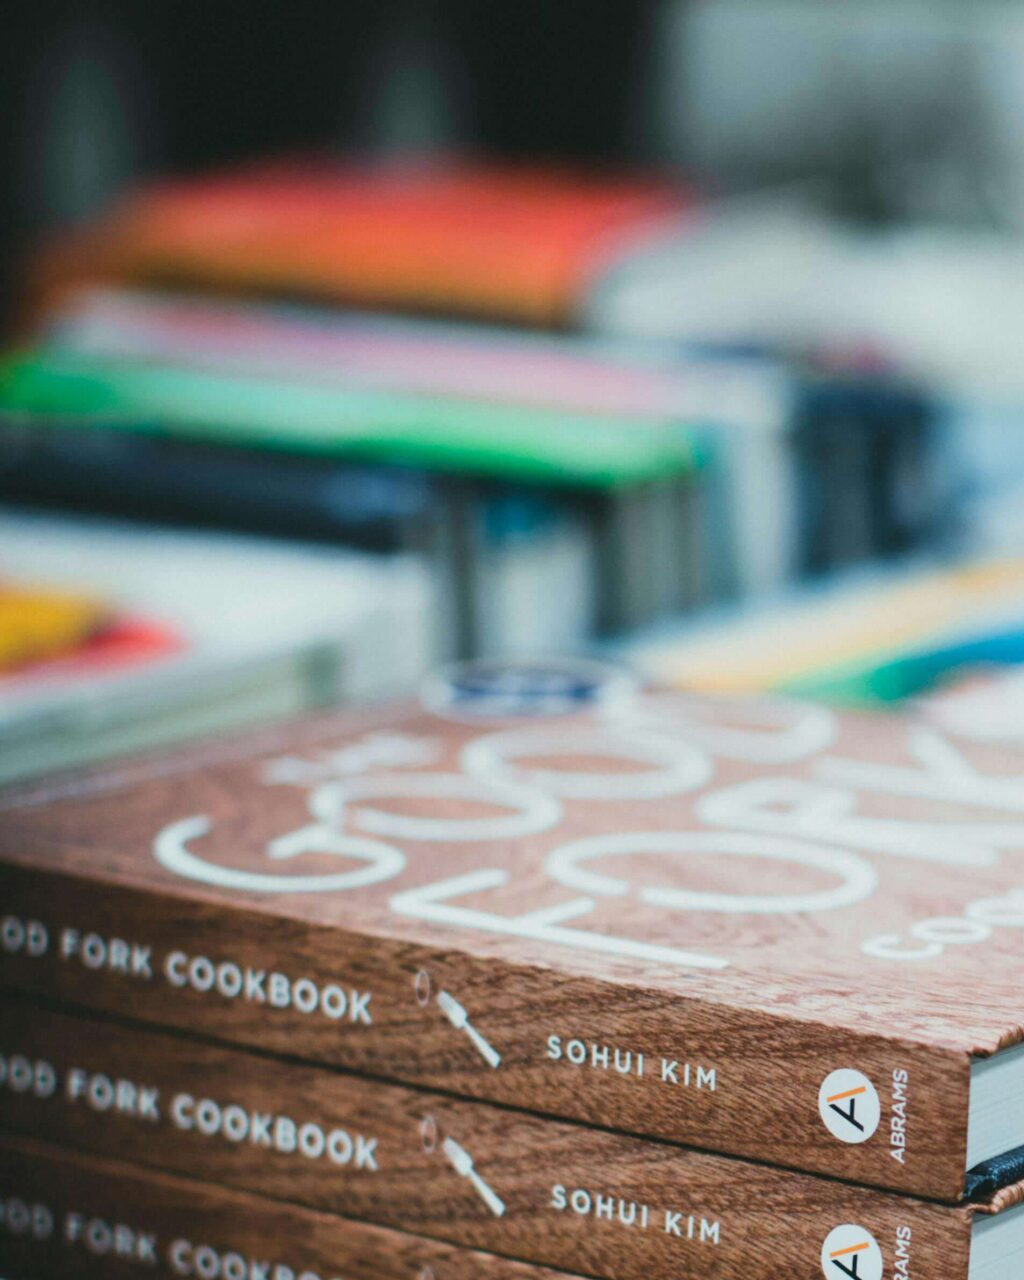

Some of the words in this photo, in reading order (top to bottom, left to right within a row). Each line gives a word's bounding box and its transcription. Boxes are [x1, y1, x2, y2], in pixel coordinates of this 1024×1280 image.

[153, 692, 838, 893] GOOD
[0, 915, 48, 956] OD
[61, 928, 152, 979] FORK
[165, 951, 372, 1025] COOKBOOK
[547, 1036, 644, 1077] SOHUI
[661, 1059, 716, 1091] KIM
[0, 1054, 56, 1098] OD
[68, 1068, 160, 1122] FORK
[172, 1094, 379, 1171] COOKBOOK
[890, 1069, 908, 1164] ABRAMS
[66, 1211, 156, 1266] FORK
[551, 1185, 648, 1228] SOHUI
[666, 1210, 721, 1245] KIM
